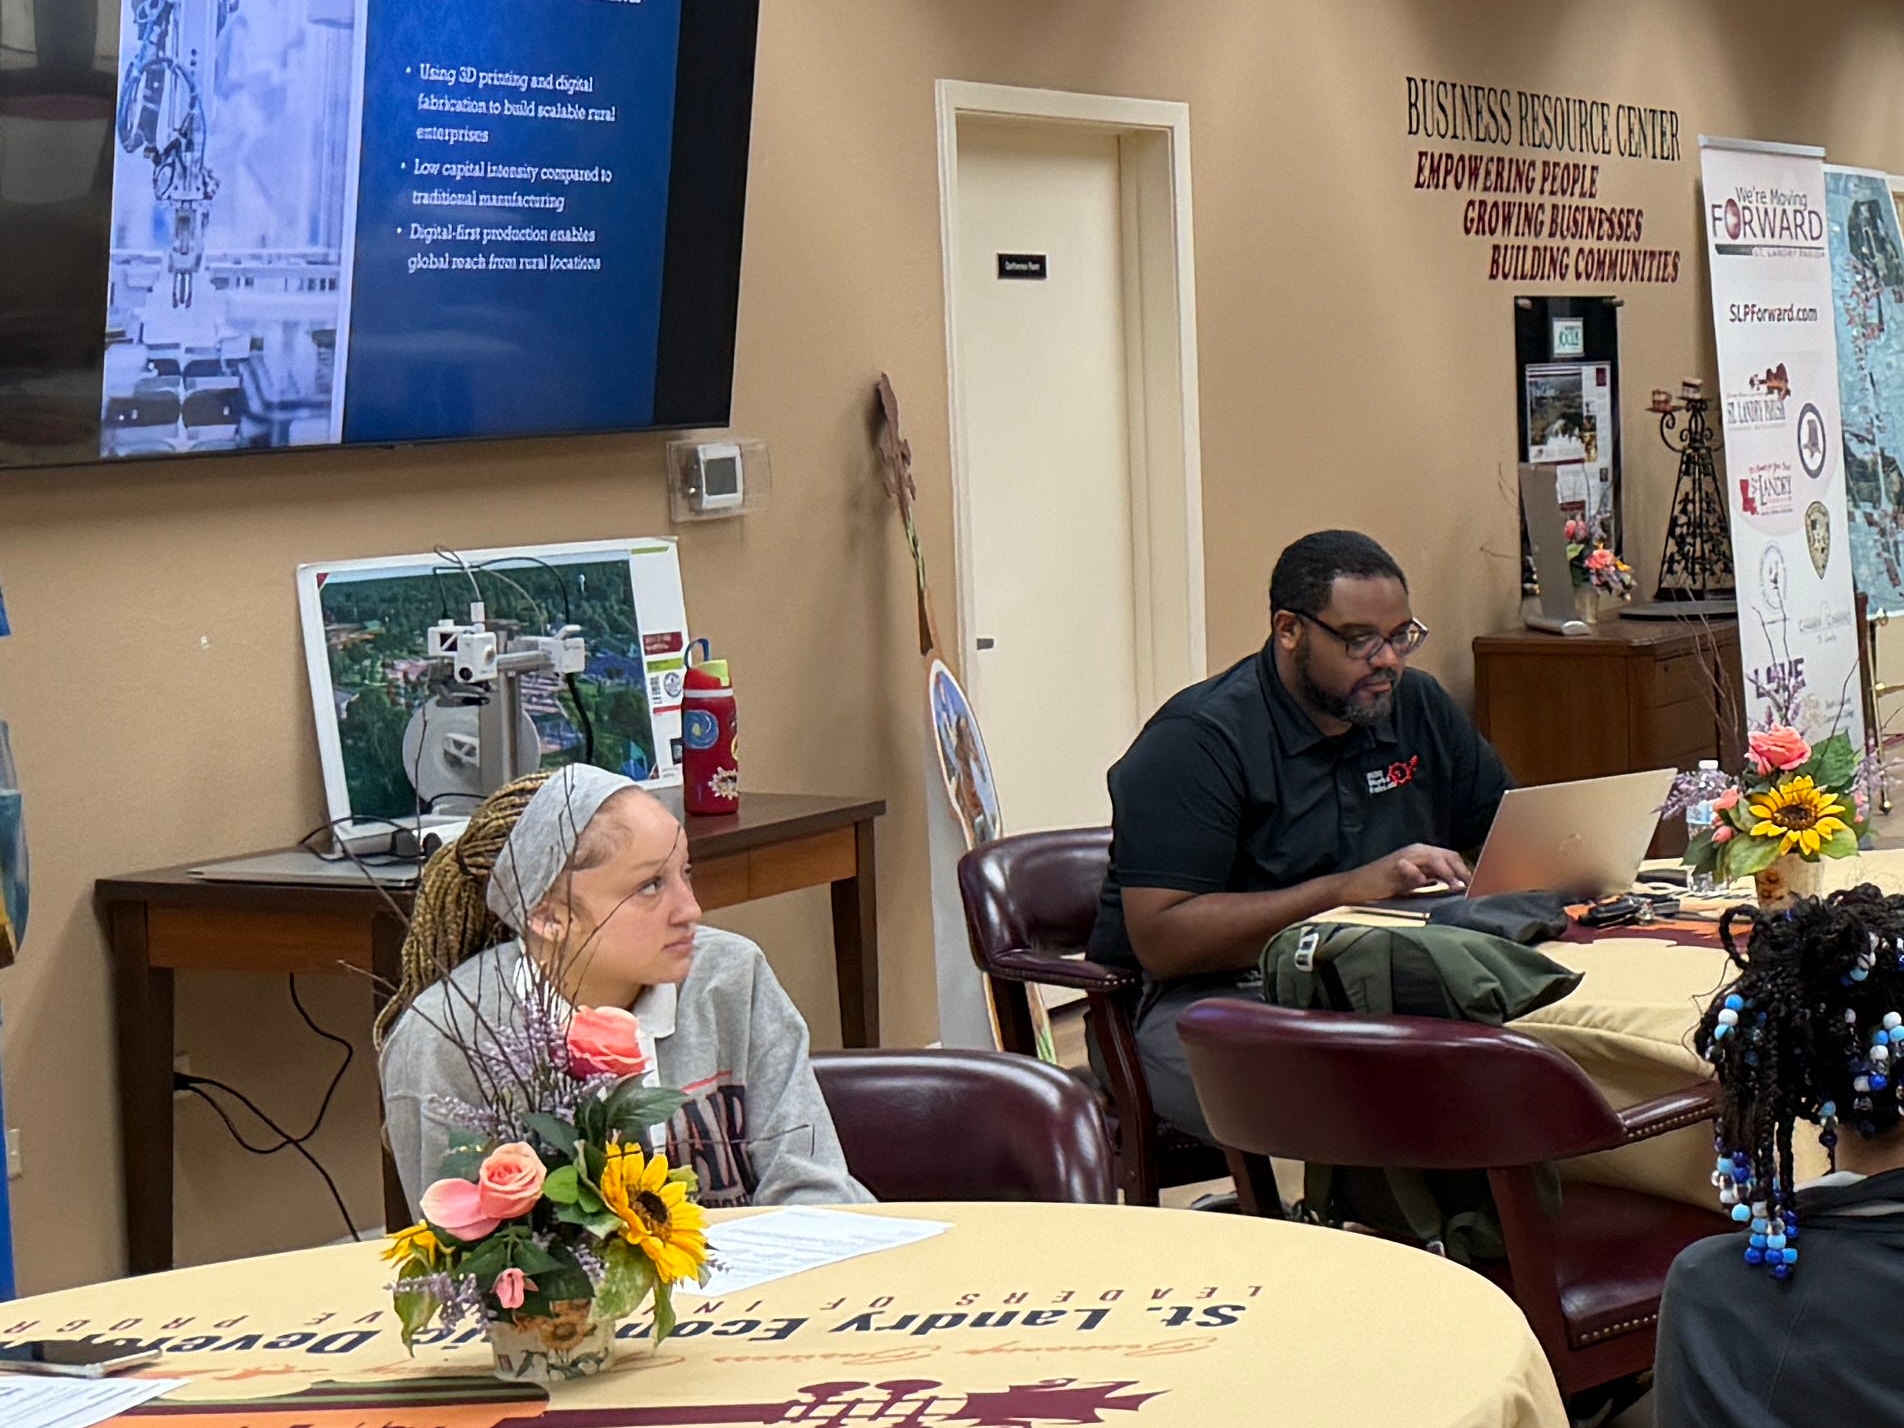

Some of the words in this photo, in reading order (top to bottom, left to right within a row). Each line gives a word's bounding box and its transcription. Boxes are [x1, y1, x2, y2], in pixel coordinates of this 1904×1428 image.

[420, 63, 456, 86] Using
[459, 66, 477, 83] 3D
[478, 69, 529, 92] printing
[531, 73, 553, 90] and
[556, 74, 594, 95] digital
[417, 93, 487, 114] fabrication
[489, 100, 501, 114] to
[503, 99, 536, 117] build
[537, 102, 586, 120] scalable
[588, 106, 616, 122] rural
[1405, 76, 1512, 147] BUSINESS
[1517, 90, 1612, 156] RESOURCE
[1616, 104, 1681, 162] CENTER
[416, 125, 489, 145] enterprises
[413, 158, 440, 176] Low
[442, 160, 485, 180] capital
[487, 163, 539, 183] intensity
[541, 166, 599, 185] compared
[601, 168, 613, 183] to
[1414, 150, 1536, 196] EMPOWERING
[1539, 159, 1600, 200] PEOPLE
[412, 188, 477, 206] traditional
[478, 191, 565, 213] manufacturing
[1735, 185, 1767, 204] We're
[1770, 188, 1808, 211] Moving
[1463, 199, 1545, 239] GROWING
[1548, 202, 1644, 243] BUSINESSES
[1711, 198, 1824, 242] FORWARD
[409, 223, 481, 244] Digital-first
[482, 224, 548, 245] production
[550, 226, 596, 243] enables
[407, 252, 450, 273] global
[451, 253, 486, 269] reach
[488, 253, 516, 269] from
[519, 254, 548, 270] rural
[549, 254, 601, 271] locations
[1489, 244, 1570, 282] BUILDING
[1575, 247, 1681, 284] COMMUNITIES
[1729, 303, 1818, 323] SLPForward.com
[820, 1296, 895, 1311] OF
[954, 1285, 1262, 1306] LEADERS
[828, 1308, 1112, 1336] Landry
[1146, 1304, 1247, 1328] St.
